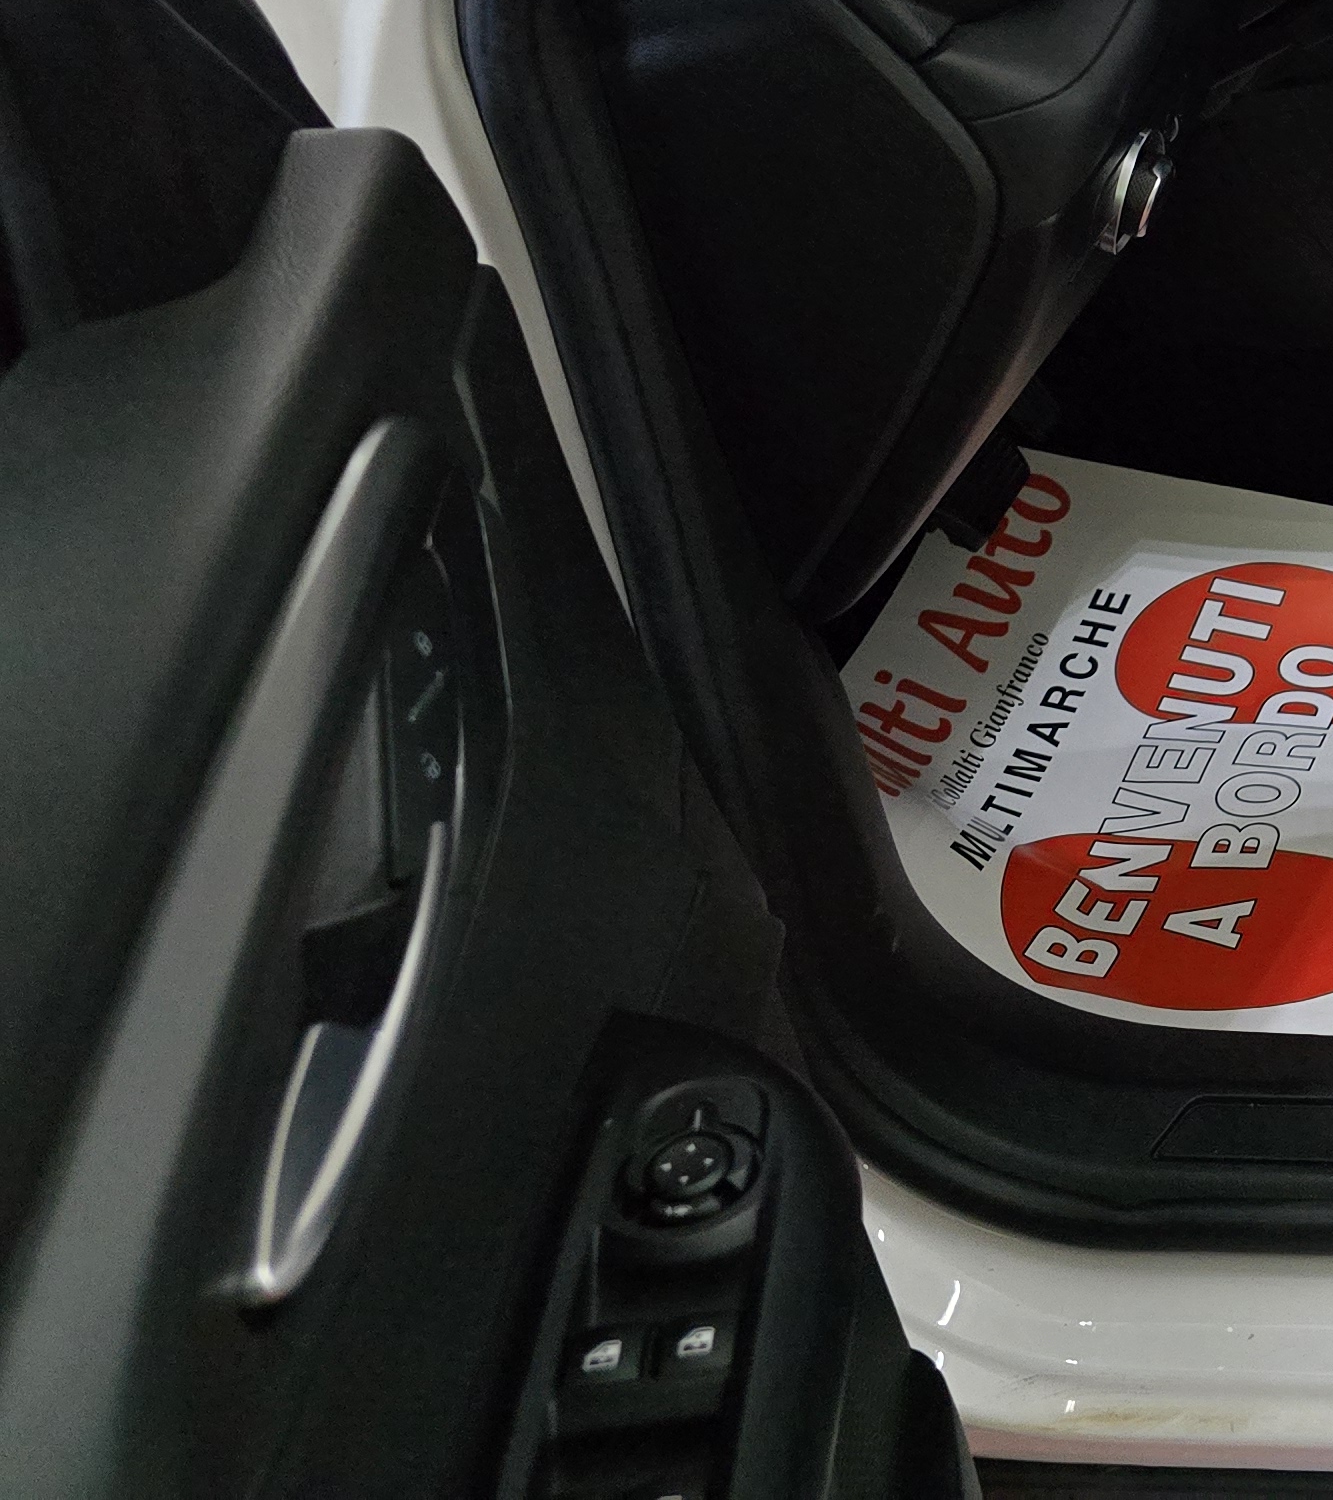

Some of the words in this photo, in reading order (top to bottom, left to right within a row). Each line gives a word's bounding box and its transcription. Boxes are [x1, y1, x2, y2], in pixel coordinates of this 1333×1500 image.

[931, 749, 985, 806] Collalti
[969, 631, 1050, 749] Gianfranco
[949, 587, 1132, 872] MULTIMARCHE
[1022, 576, 1287, 979] BENVENUTI
[1162, 899, 1258, 950] A
